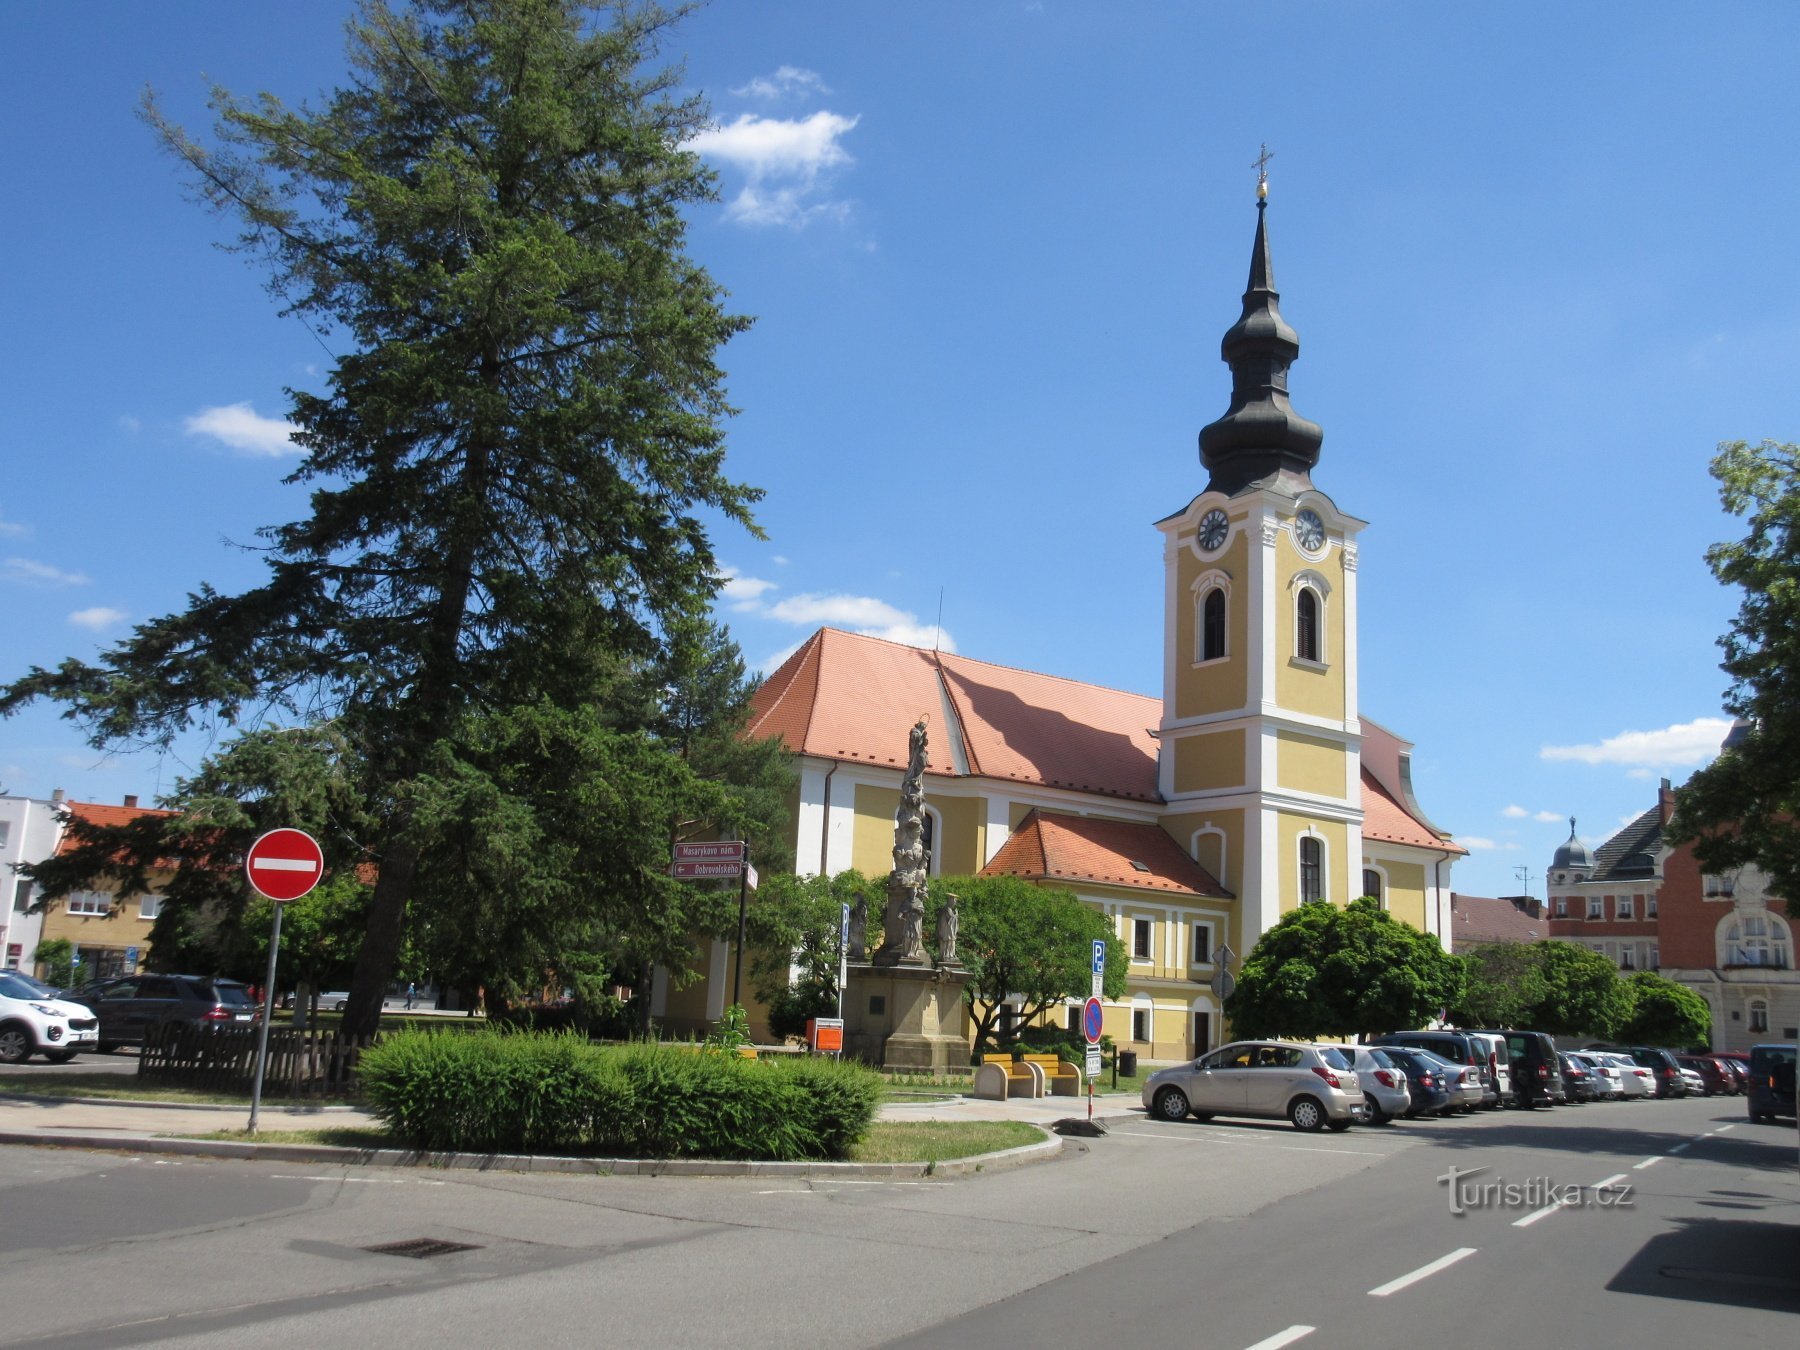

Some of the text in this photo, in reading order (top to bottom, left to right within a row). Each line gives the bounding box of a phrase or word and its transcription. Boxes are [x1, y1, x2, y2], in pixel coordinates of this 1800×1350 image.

[683, 846, 735, 857] Masarykovo nám.
[694, 863, 739, 875] Dobrovolského
[1095, 945, 1102, 963] P
